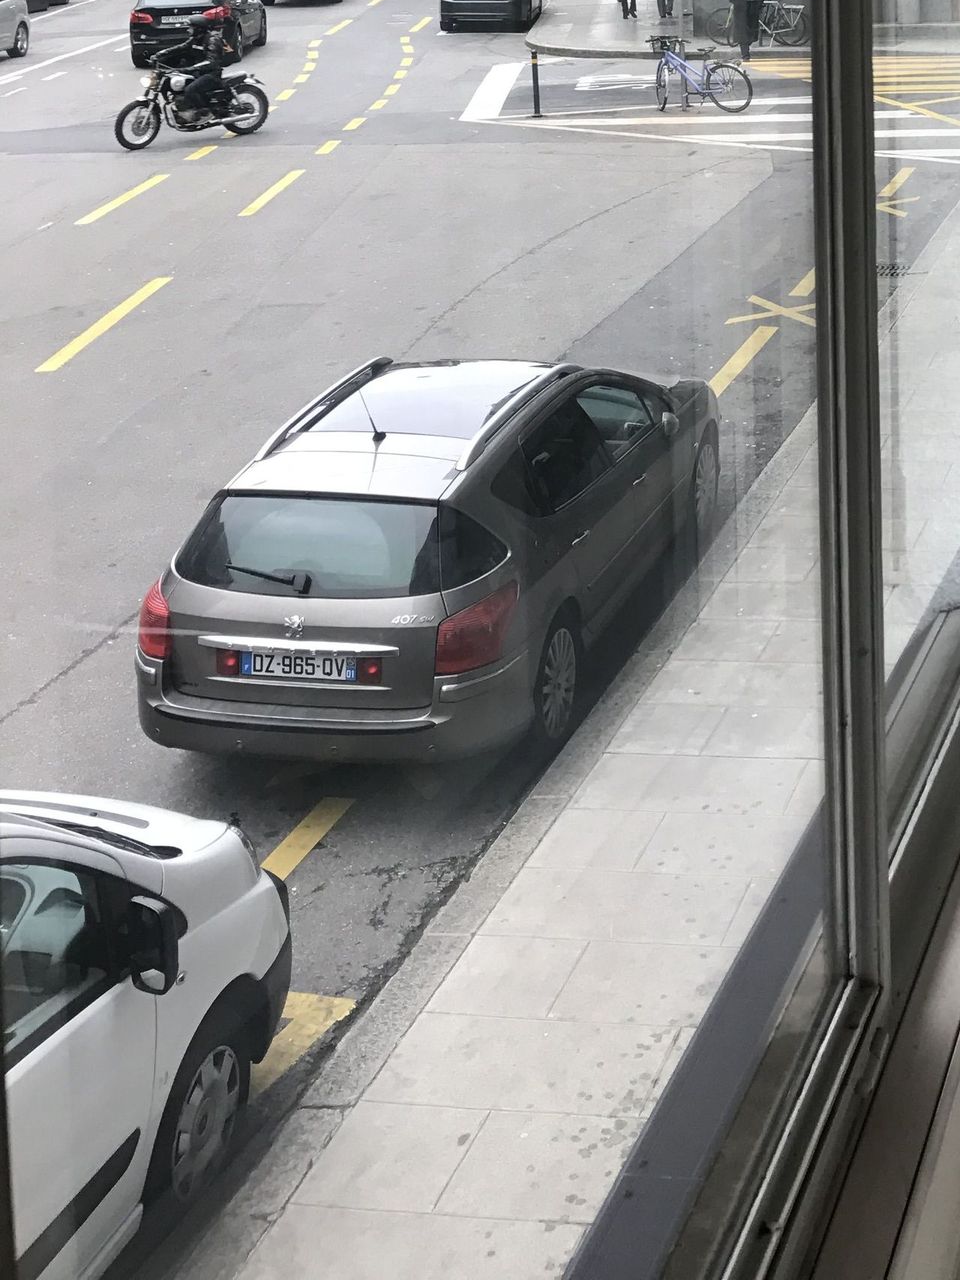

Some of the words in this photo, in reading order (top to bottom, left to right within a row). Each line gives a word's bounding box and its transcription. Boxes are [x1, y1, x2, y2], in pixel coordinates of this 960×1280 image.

[391, 614, 418, 625] 407
[253, 653, 346, 678] DZ-965-QV
[346, 669, 355, 679] 01
